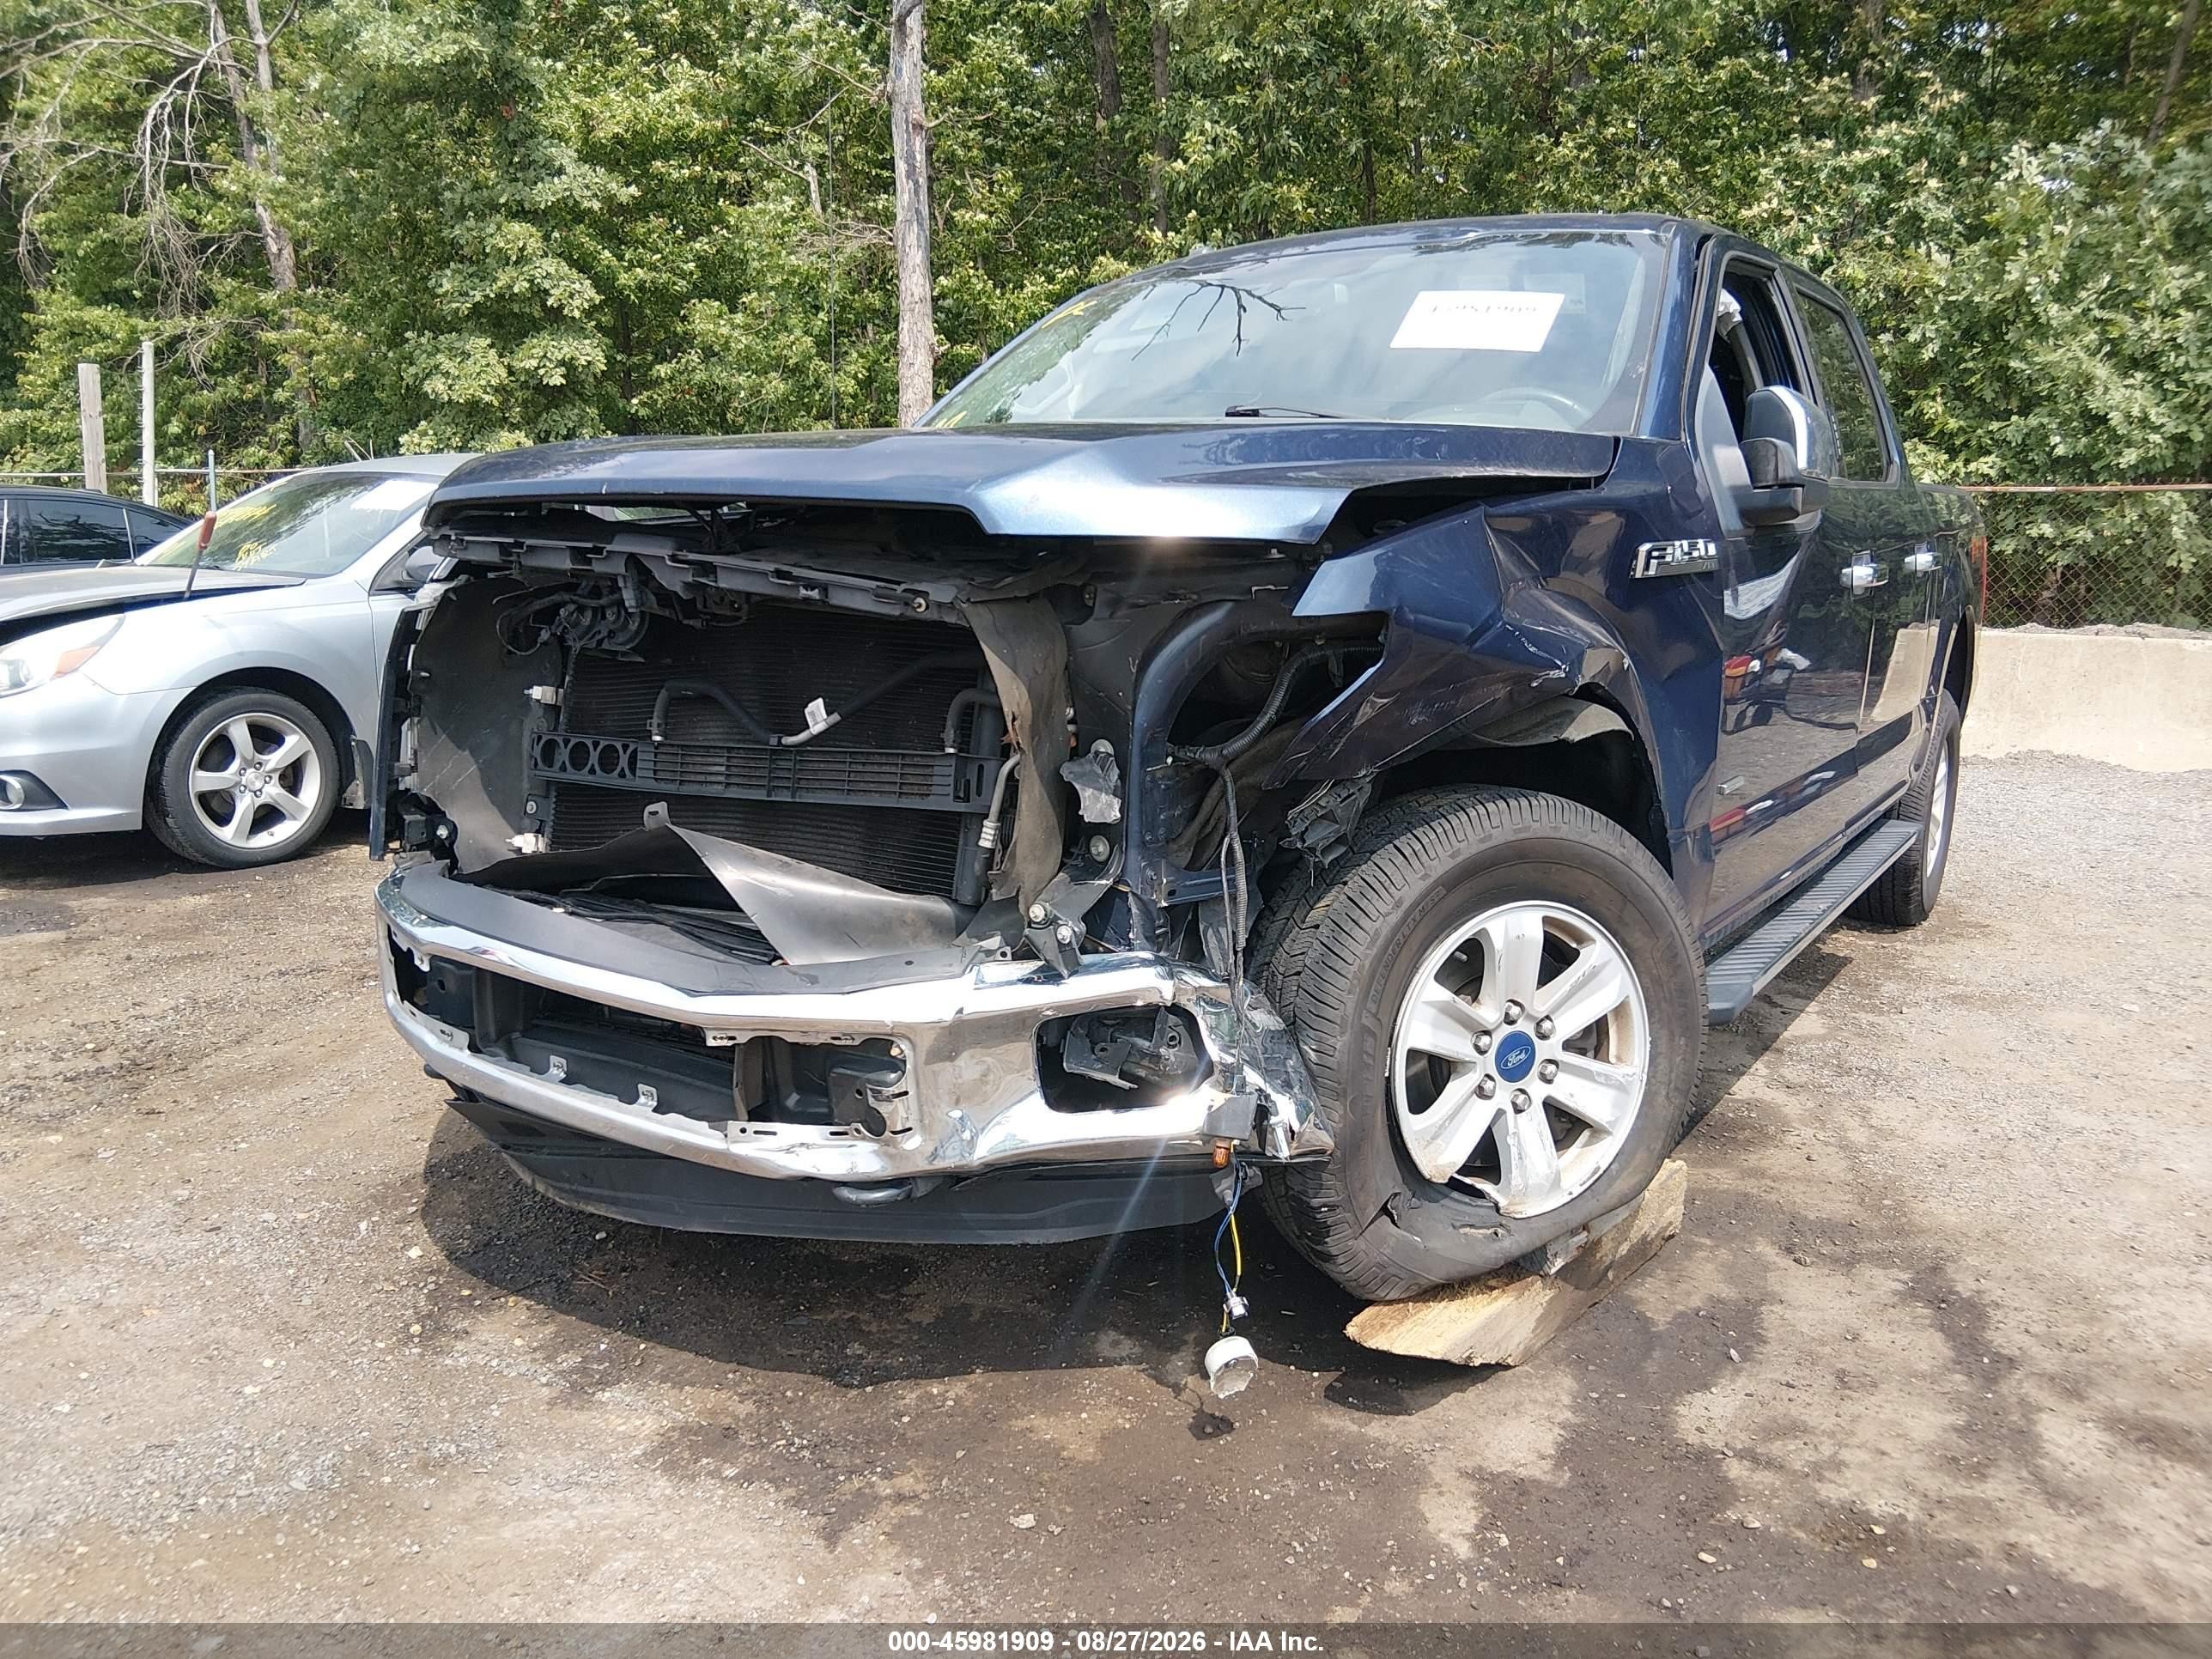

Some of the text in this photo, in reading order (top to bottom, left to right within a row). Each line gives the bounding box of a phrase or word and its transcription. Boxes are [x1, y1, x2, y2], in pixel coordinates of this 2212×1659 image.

[1370, 938, 1402, 1005] DEFENDER
[1401, 915, 1419, 940] LTX
[1507, 1049, 1526, 1066] Ford
